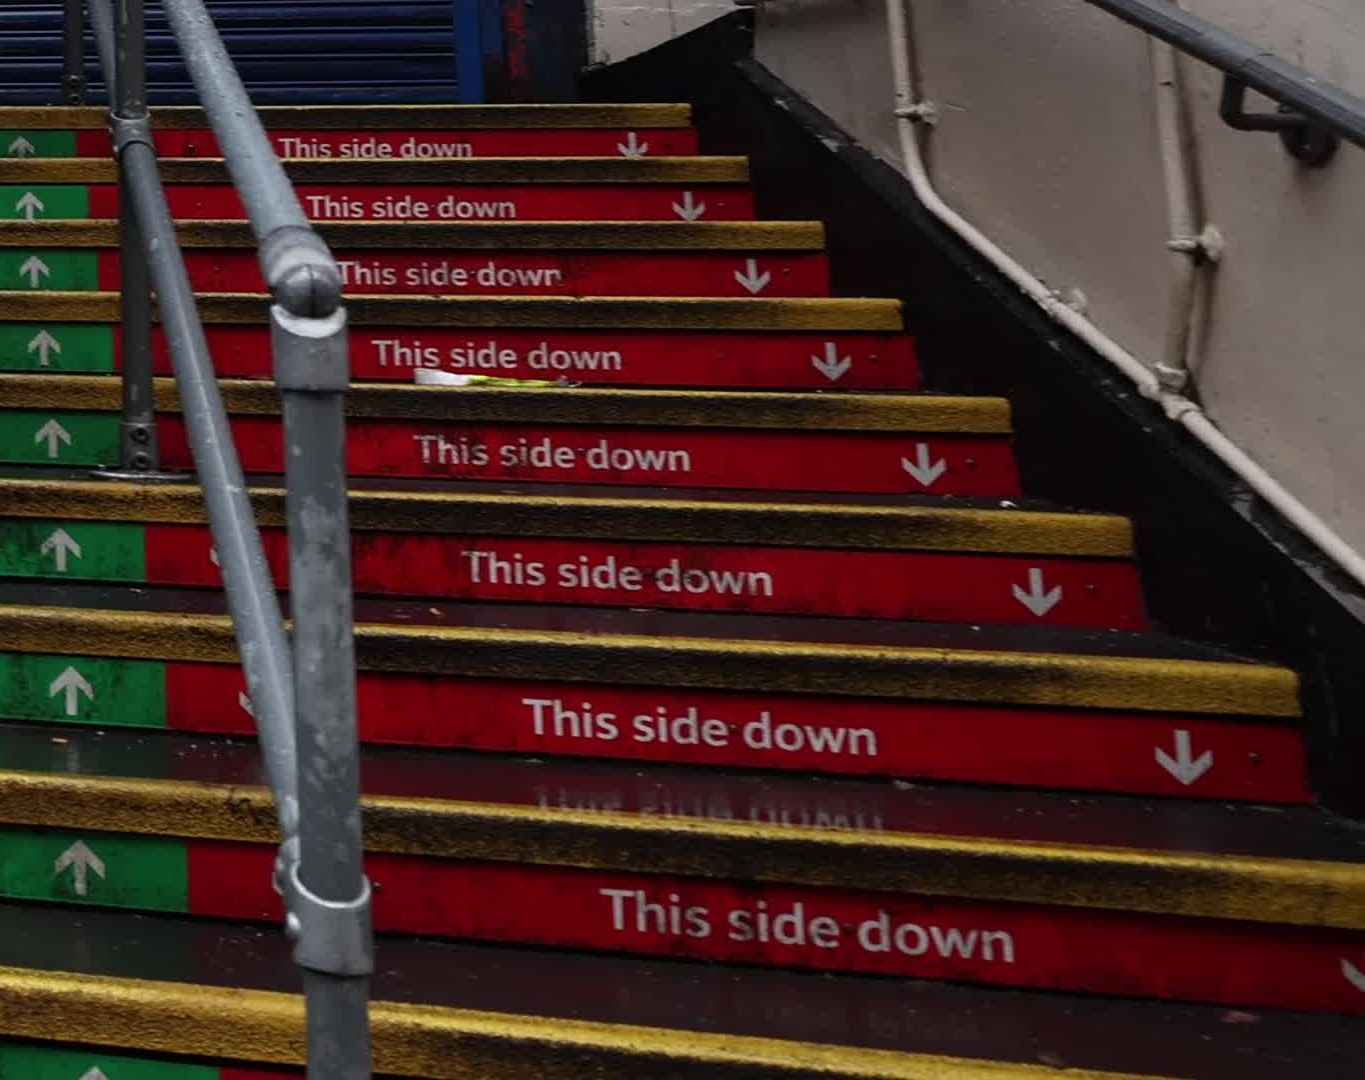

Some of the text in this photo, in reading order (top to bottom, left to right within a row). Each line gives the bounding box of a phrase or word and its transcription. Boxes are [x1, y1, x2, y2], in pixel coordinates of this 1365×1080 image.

[279, 138, 472, 158] This side down
[308, 196, 516, 218] This side down
[336, 261, 562, 287] This side down
[372, 339, 622, 370] This side down
[413, 434, 691, 472] This side down
[461, 551, 773, 596] This side down
[523, 699, 877, 756] This side down
[600, 889, 1015, 964] This side down
